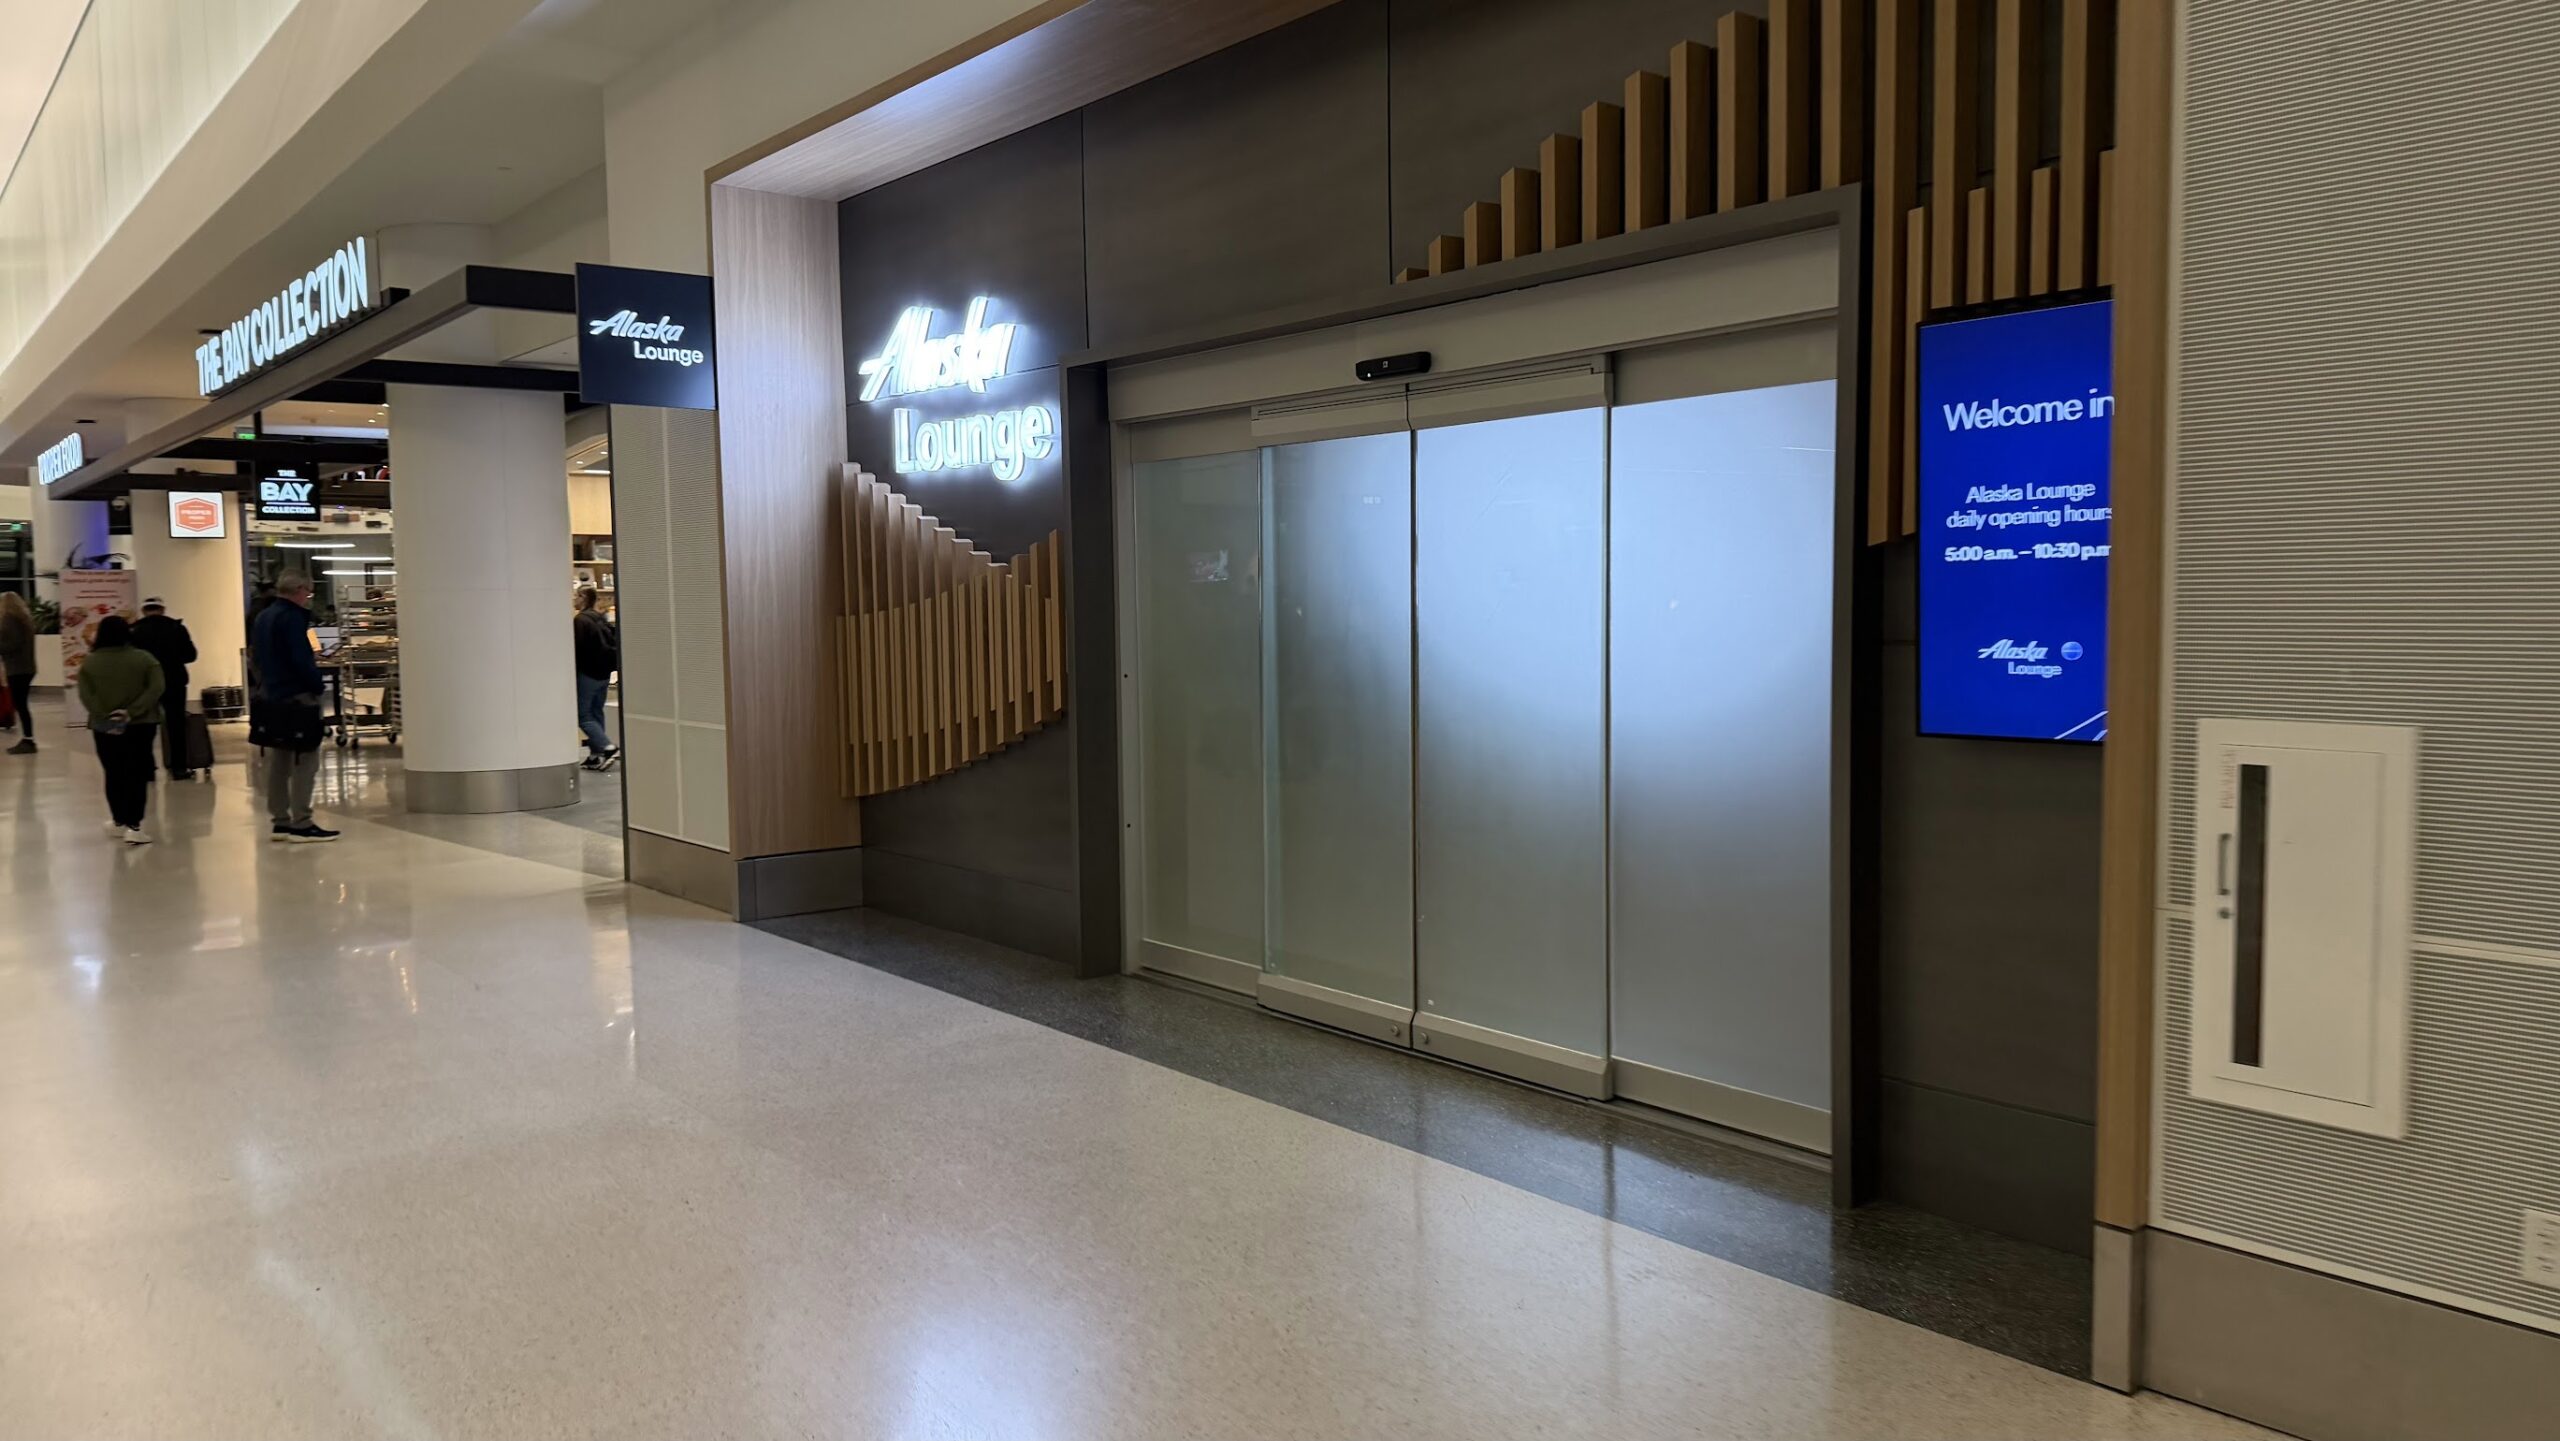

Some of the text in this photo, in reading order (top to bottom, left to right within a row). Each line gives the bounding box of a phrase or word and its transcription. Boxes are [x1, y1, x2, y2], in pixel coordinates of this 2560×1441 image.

[195, 236, 368, 396] THE BAY COLLECTION
[589, 309, 685, 344] Alaska
[633, 341, 704, 367] Lounge
[858, 296, 1016, 401] Alaska
[1943, 398, 2084, 432] Welcome
[894, 405, 1054, 481] Lounge
[277, 469, 297, 477] THE
[260, 482, 314, 501] BAY
[1965, 482, 2096, 504] Alaska Lounge
[261, 505, 316, 514] COLLECTION
[1946, 509, 1987, 531] daily
[1988, 506, 2061, 529] opening
[1944, 545, 1983, 562] 5:00
[1983, 548, 2018, 560] a.m.
[2032, 542, 2080, 559] 10:30
[1977, 638, 2048, 662] Alaska
[2008, 661, 2062, 678] Lounge
